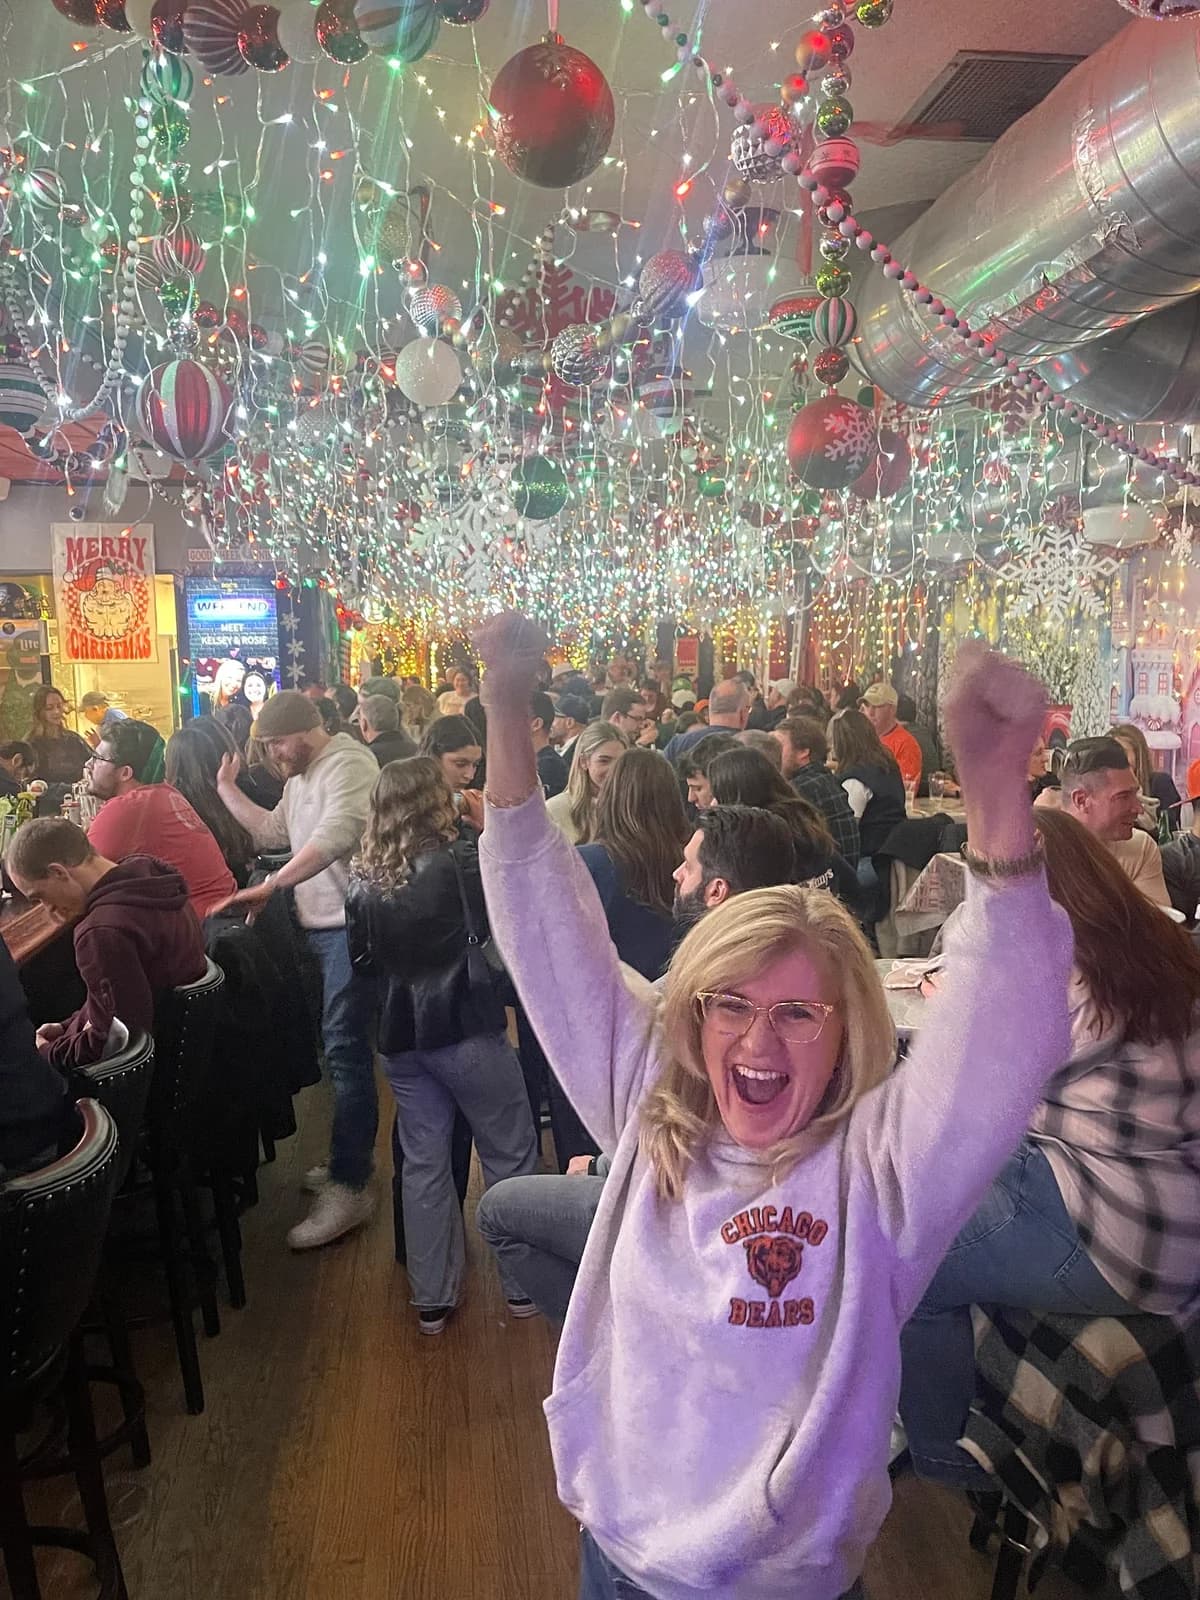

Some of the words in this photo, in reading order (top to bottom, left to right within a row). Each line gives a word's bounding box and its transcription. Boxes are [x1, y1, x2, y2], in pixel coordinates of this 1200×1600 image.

[65, 537, 147, 573] MERRY
[197, 602, 268, 611] WEEND
[65, 626, 151, 660] CHRISTMAS
[201, 636, 232, 645] KELSEY
[242, 636, 268, 645] ROSIE
[220, 623, 244, 632] MEET
[720, 1205, 828, 1246] CHICAGO
[728, 1297, 815, 1328] BEARS
